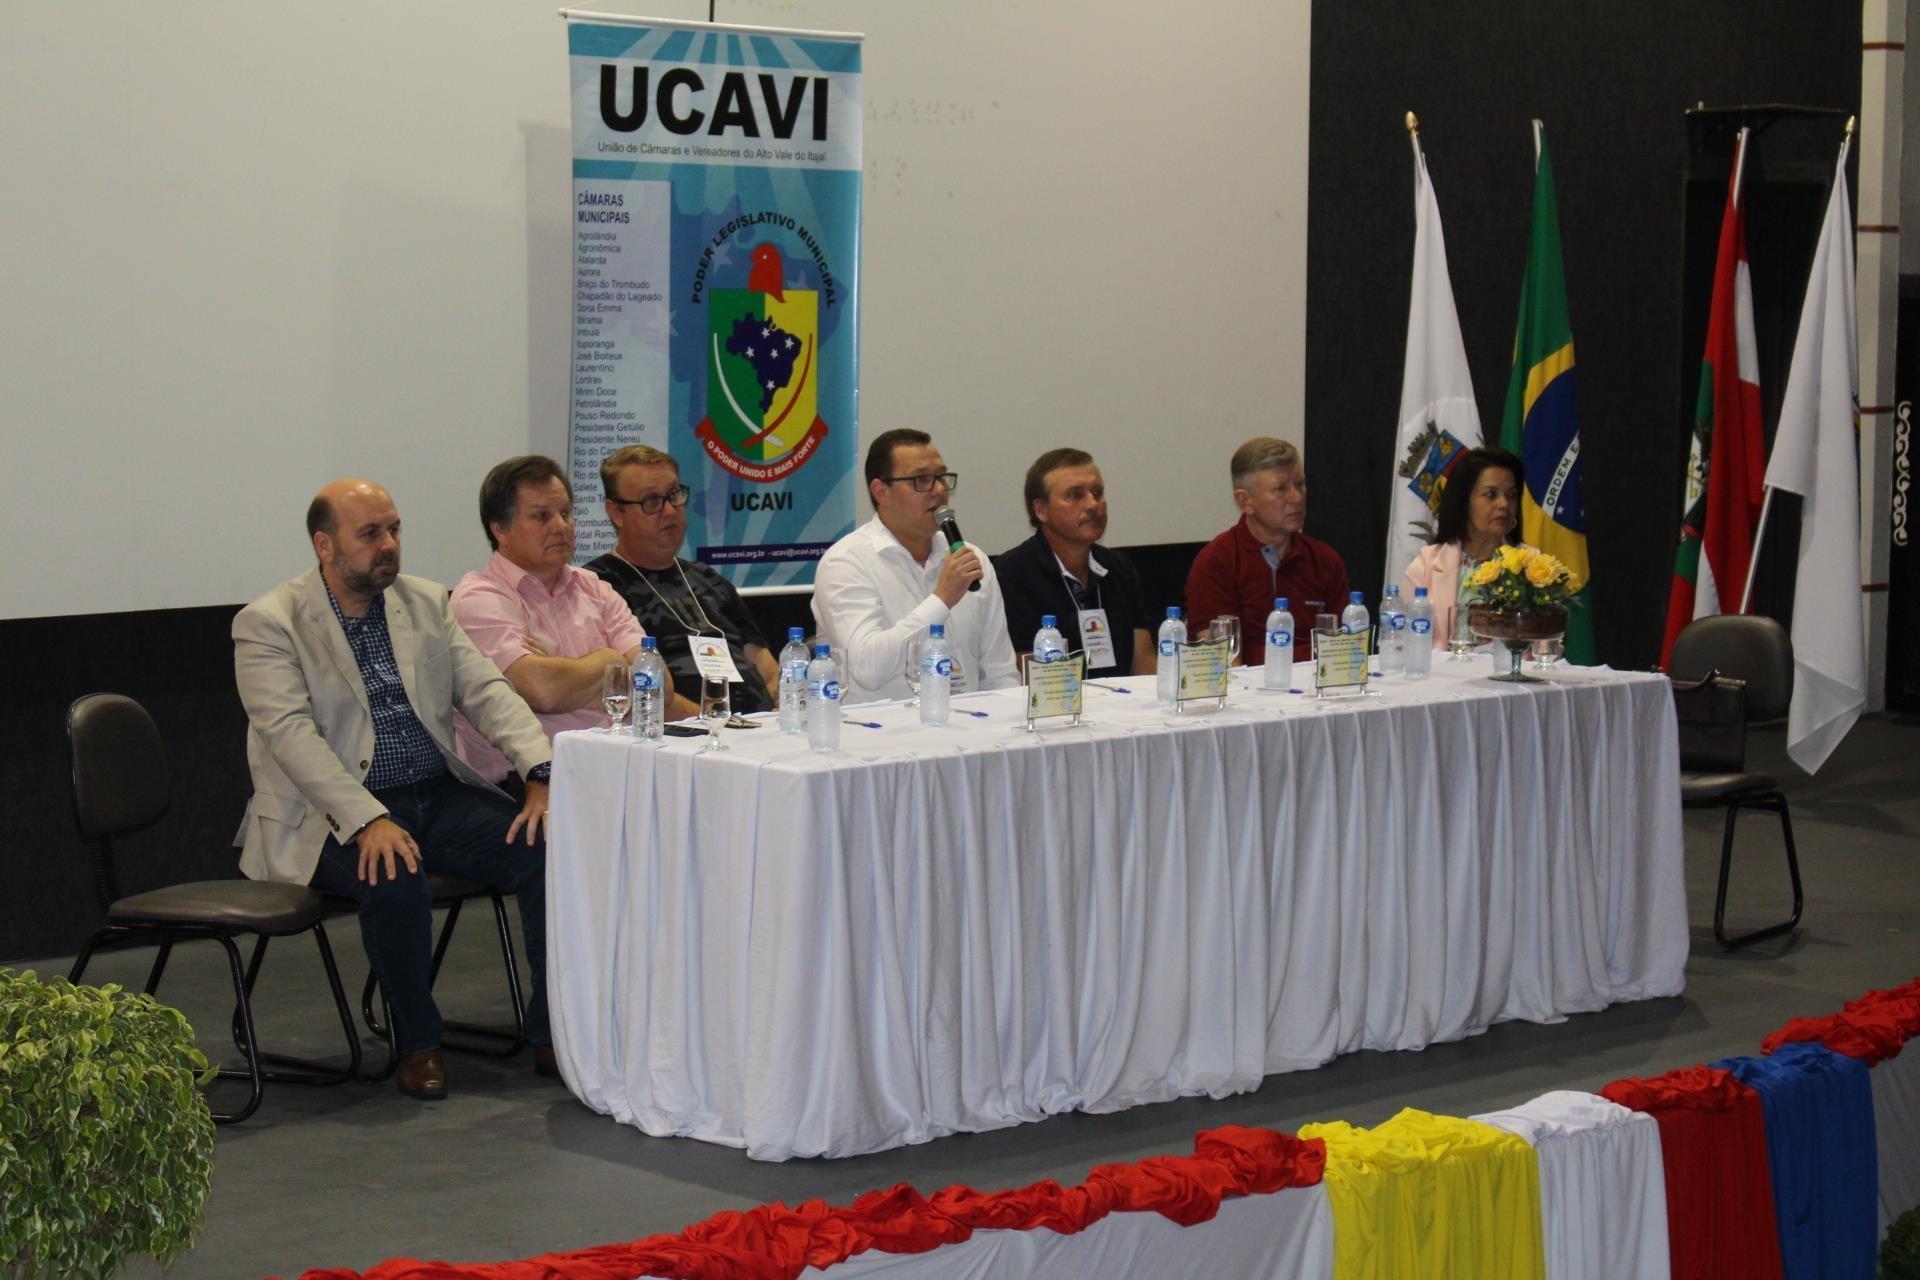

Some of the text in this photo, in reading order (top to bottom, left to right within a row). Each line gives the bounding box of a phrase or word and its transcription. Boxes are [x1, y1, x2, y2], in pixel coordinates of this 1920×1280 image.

[600, 64, 829, 141] UCAVI
[598, 141, 625, 153] União
[626, 143, 638, 153] de
[640, 142, 681, 155] Câmaras
[684, 147, 690, 155] e
[692, 144, 740, 158] Vereadores
[743, 148, 755, 159] do
[756, 148, 773, 159] Alto
[775, 149, 793, 160] Vale
[795, 150, 806, 161] do
[578, 190, 624, 207] CÂMARAS
[578, 211, 630, 224] MUNICIPAIS
[692, 212, 836, 310] PODER LEGISLATIVO MUNICIPAL
[578, 267, 601, 276] Aurora
[600, 279, 610, 289] do
[612, 279, 650, 289] Trombudo
[616, 291, 626, 301] do
[597, 303, 622, 313] Emma
[575, 363, 615, 373] Laurentino
[576, 376, 602, 385] Lontras
[596, 387, 617, 396] Doce
[600, 410, 636, 420] Redondo
[575, 422, 615, 432] Presidente
[575, 434, 640, 444] Presidente Nereu
[574, 446, 617, 456] Rio do Cam
[713, 446, 739, 470] PODER
[740, 466, 766, 478] UNIDO
[774, 460, 794, 475] MAIS
[793, 436, 816, 462] FORTE
[574, 459, 586, 468] Rio
[588, 459, 598, 468] do
[574, 471, 598, 480] Rio do
[1546, 443, 1579, 506] ORDEM E
[574, 483, 598, 492] Salete
[574, 494, 596, 504] Santa
[731, 492, 793, 511] UCAVI
[712, 550, 765, 559] www.ucavi.org.br
[772, 547, 826, 558] ucavi@ucavi.org.b
